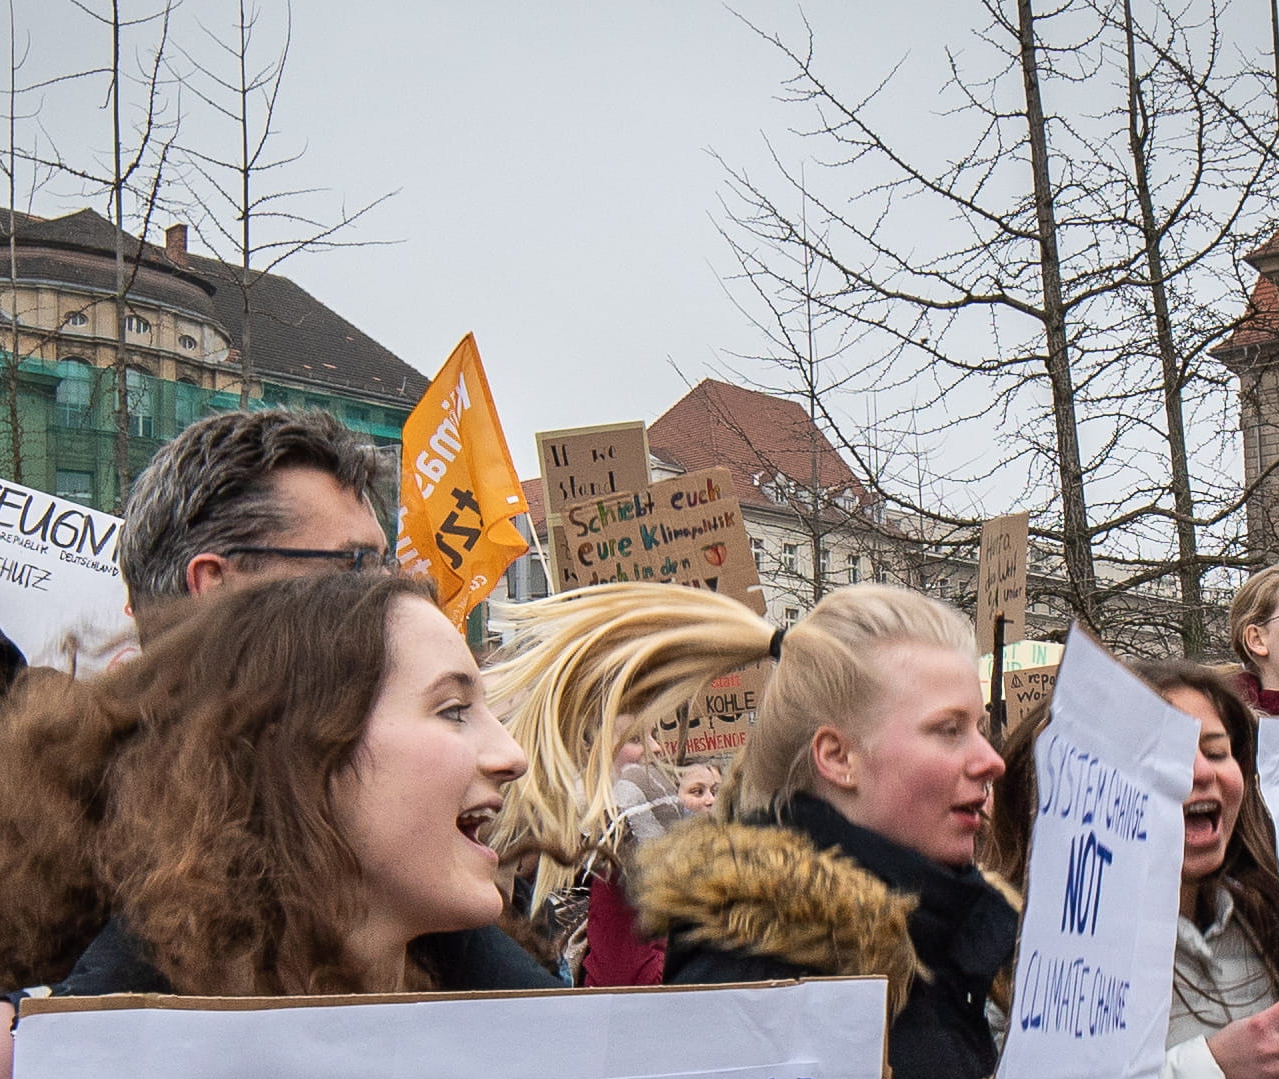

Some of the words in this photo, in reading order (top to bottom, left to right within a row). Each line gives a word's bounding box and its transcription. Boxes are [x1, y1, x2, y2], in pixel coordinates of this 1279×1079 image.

[568, 492, 655, 537] Schiebt
[670, 478, 721, 511] euch
[577, 534, 632, 567] eure
[705, 691, 756, 713] KOHLE
[1041, 734, 1109, 825] SYSTEM
[1105, 767, 1149, 841] CHANGE
[1061, 829, 1113, 937] NOT
[1021, 950, 1090, 1038] CLIMATE
[1089, 966, 1130, 1037] CHANGE
